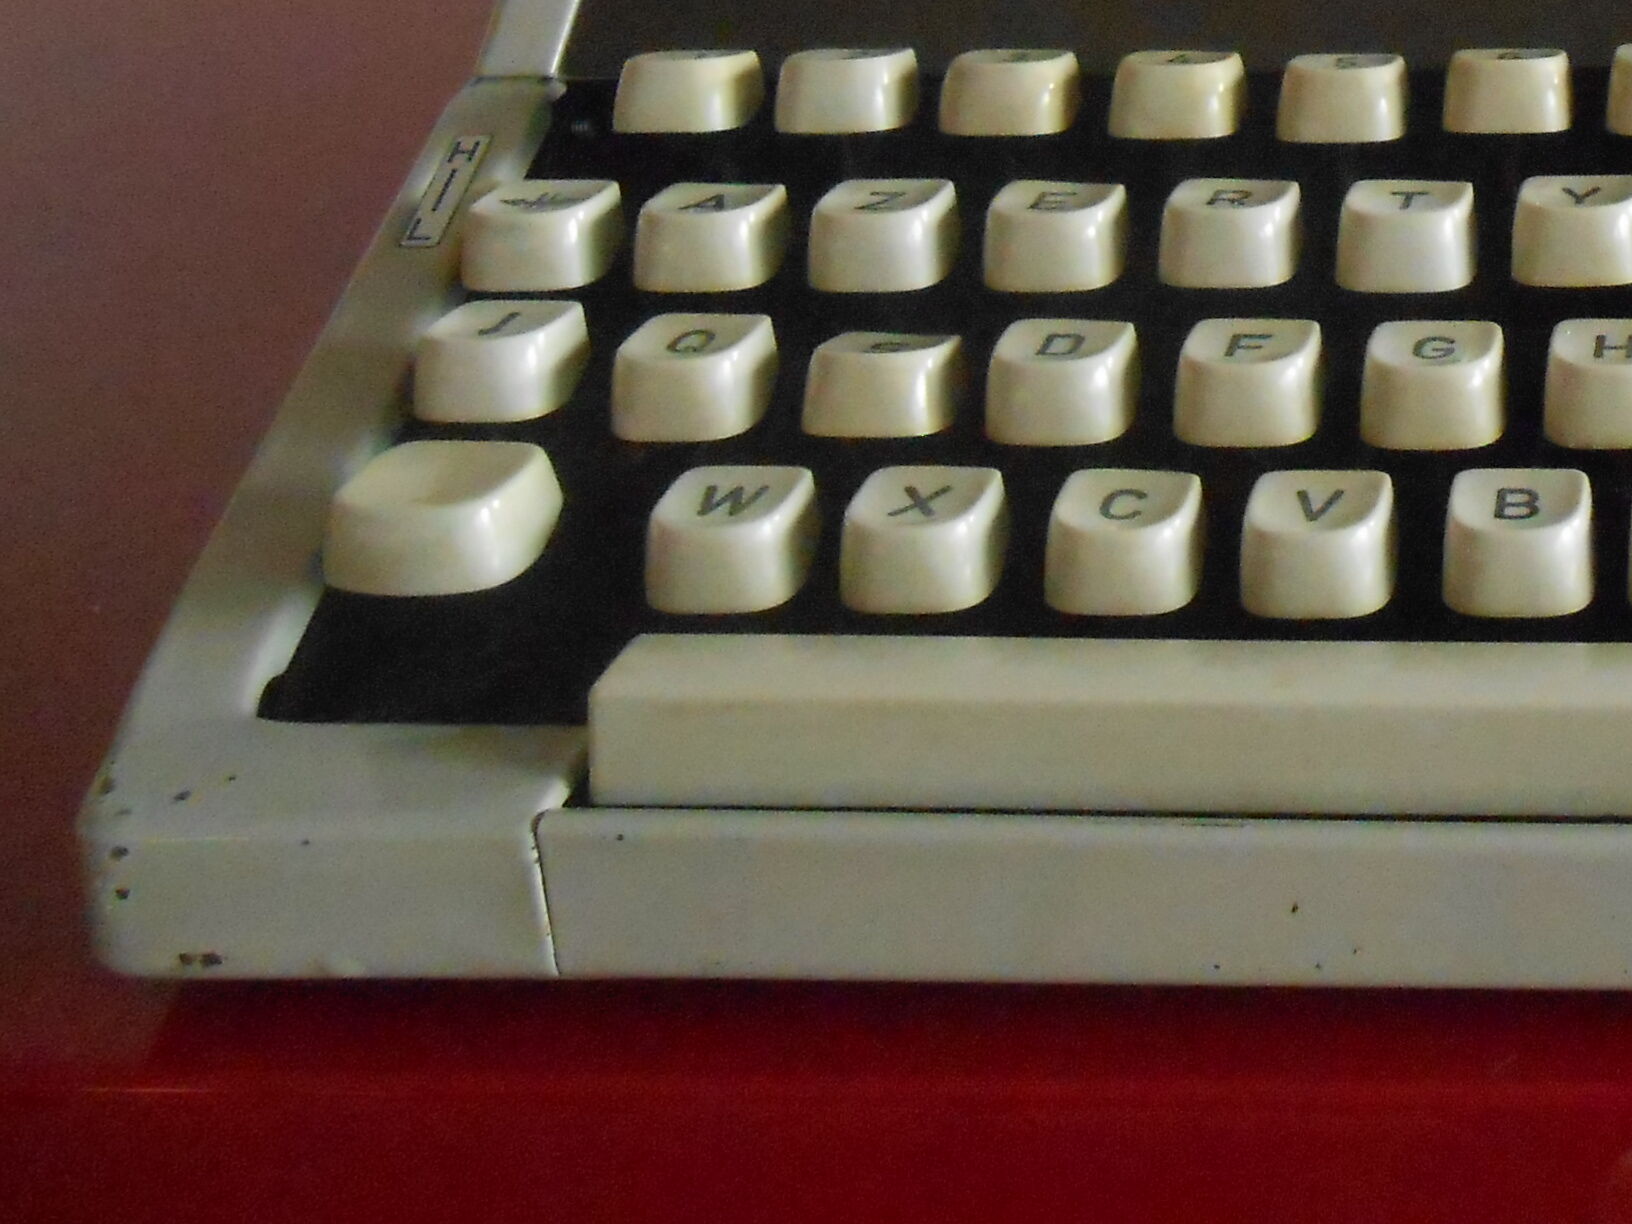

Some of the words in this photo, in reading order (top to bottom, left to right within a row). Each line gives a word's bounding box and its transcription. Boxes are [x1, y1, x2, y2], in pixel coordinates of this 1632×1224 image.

[678, 194, 725, 211] A
[854, 191, 904, 212] Z
[1026, 189, 1077, 210] E
[1204, 189, 1251, 207] R
[1388, 191, 1425, 209] T
[1560, 186, 1598, 204] Y
[1036, 333, 1084, 356] D
[1224, 333, 1272, 357] F
[1412, 336, 1454, 359] G
[696, 484, 768, 517] W
[887, 484, 952, 517] X
[1099, 488, 1146, 520] C
[1296, 489, 1343, 522] V
[1494, 487, 1539, 520] B
